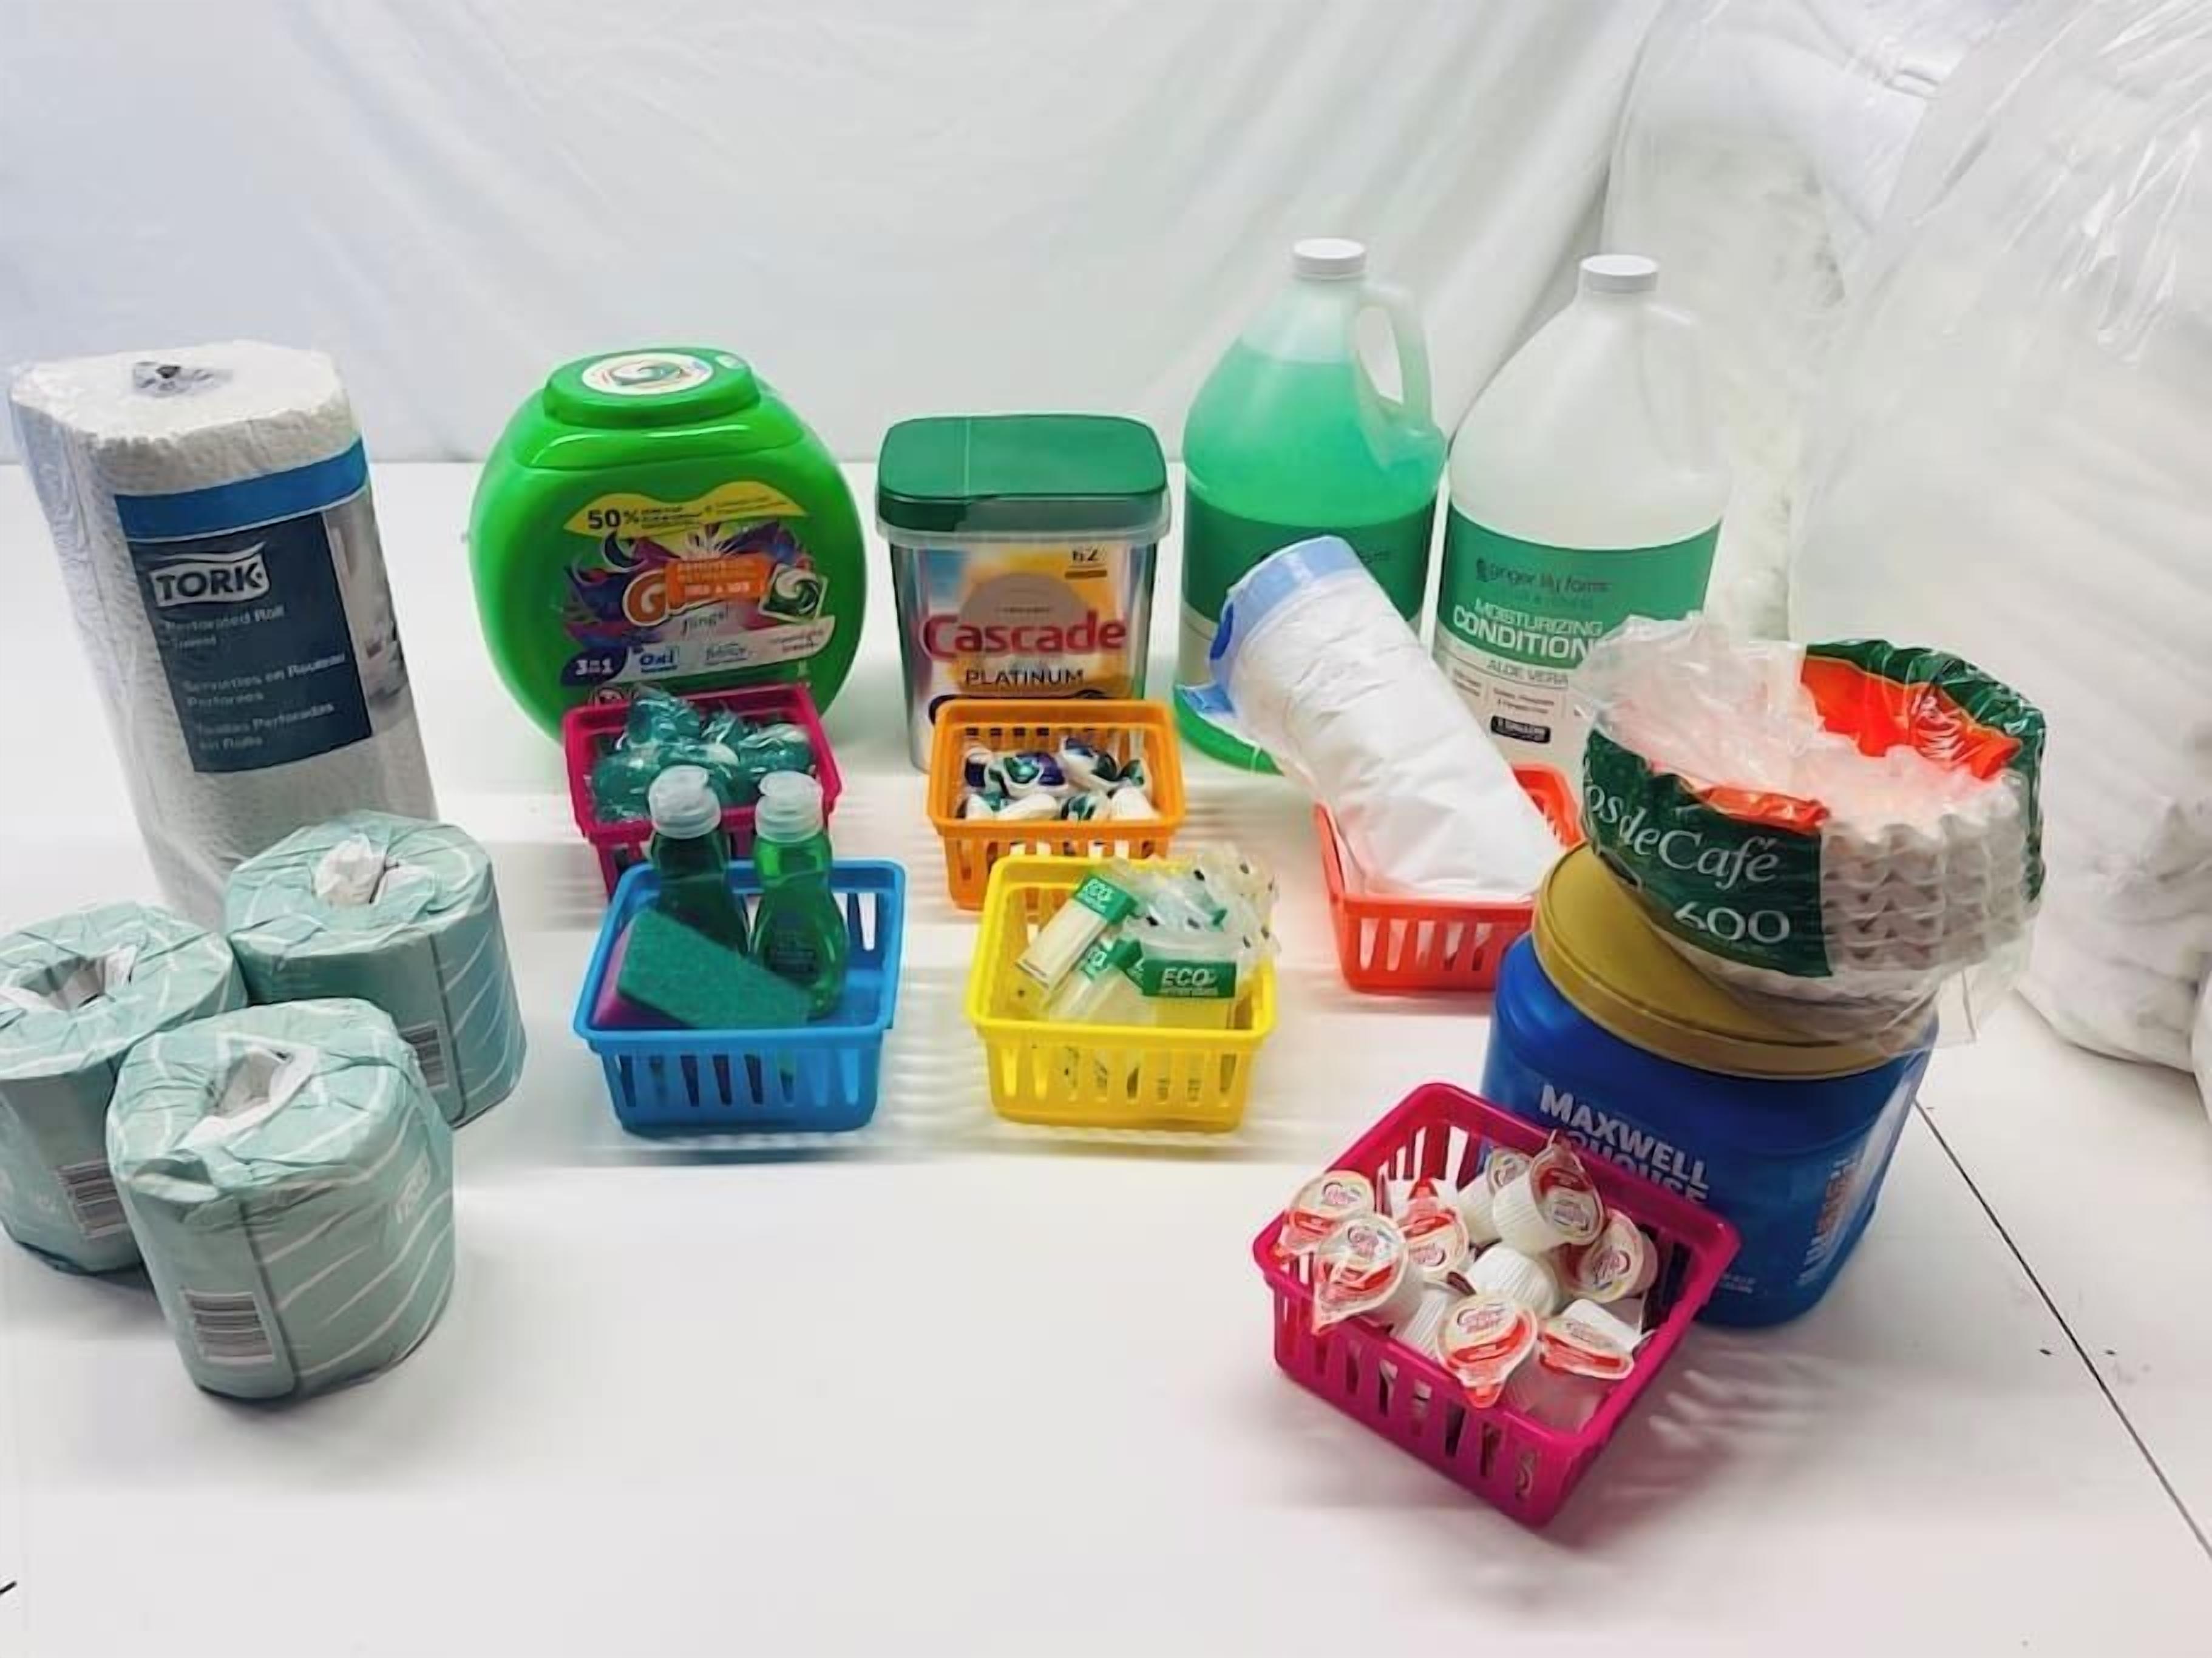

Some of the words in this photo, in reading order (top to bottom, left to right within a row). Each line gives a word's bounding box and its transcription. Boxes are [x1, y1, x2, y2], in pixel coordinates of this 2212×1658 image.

[587, 509, 640, 530] 50%
[156, 563, 259, 600] TORK
[922, 610, 1126, 661] Cascade
[965, 668, 1084, 686] PLATINUM
[1162, 968, 1210, 987] ECO
[1540, 1084, 1710, 1191] MAXWELL
